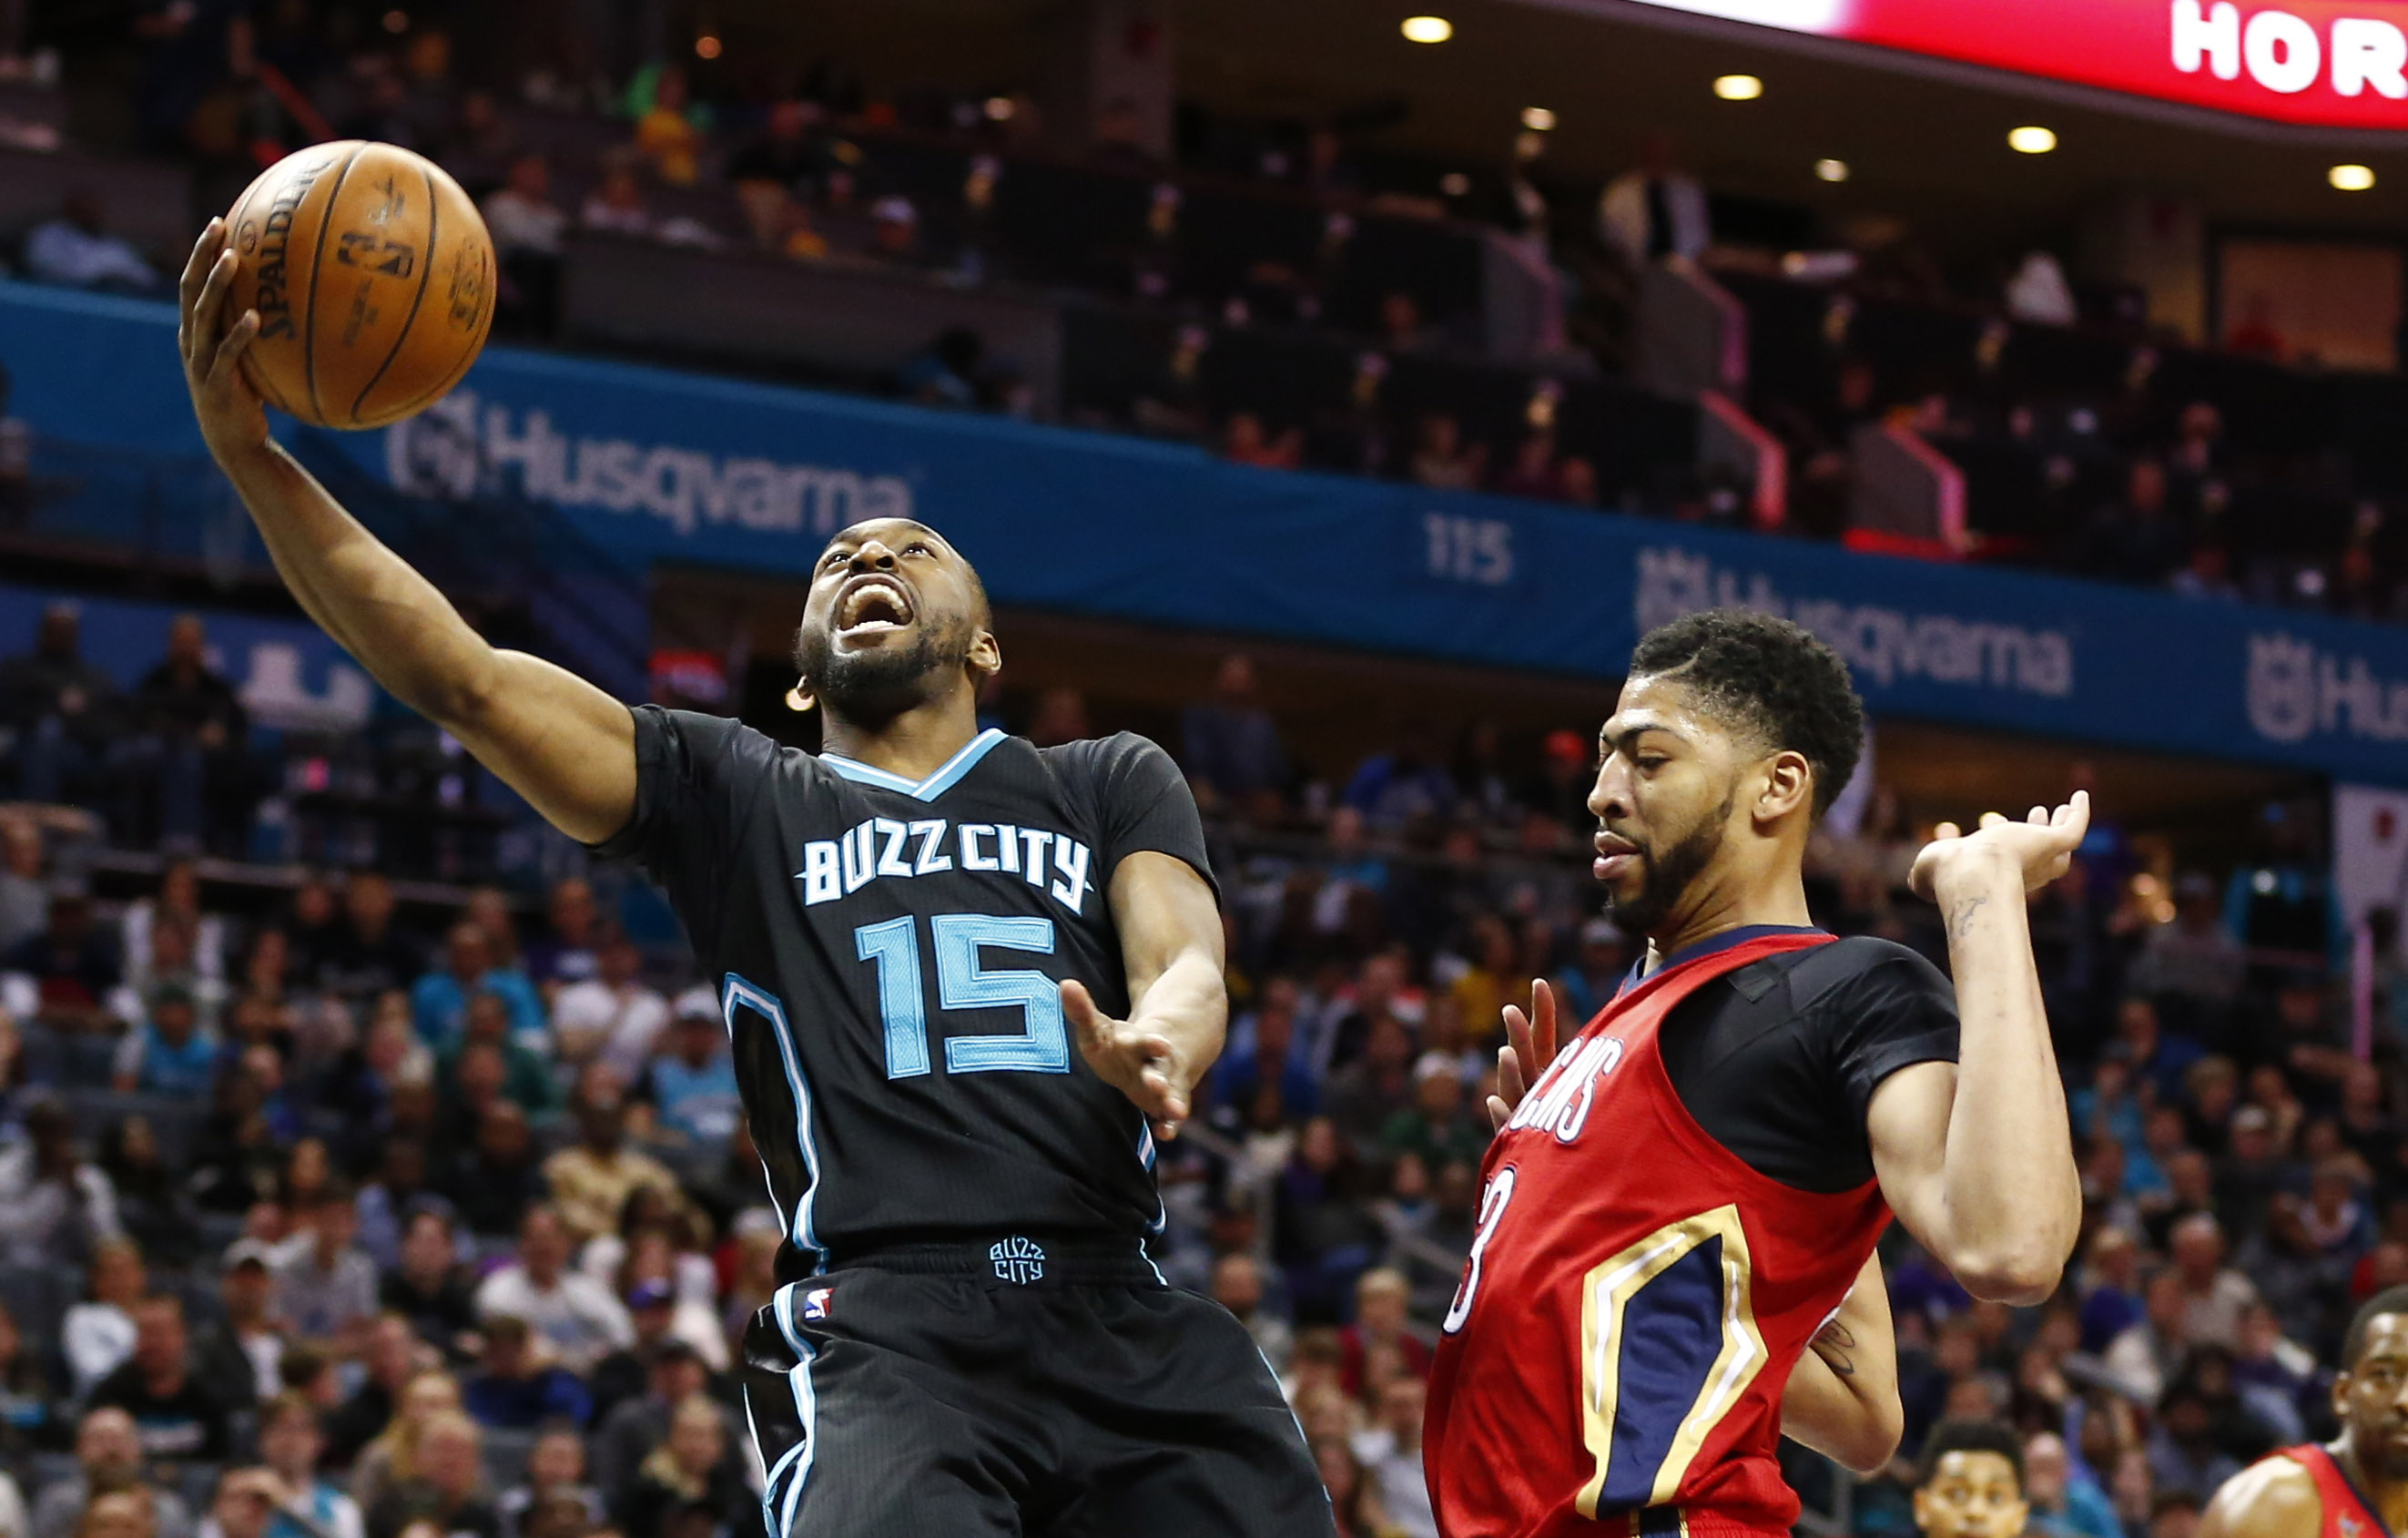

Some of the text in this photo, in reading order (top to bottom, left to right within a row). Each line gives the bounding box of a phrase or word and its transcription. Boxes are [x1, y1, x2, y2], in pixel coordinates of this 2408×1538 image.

[2173, 0, 2408, 98] HOR
[484, 402, 911, 535] Husqvarna
[1425, 514, 1512, 581] 115
[795, 818, 1094, 916] BUZZ CITY
[855, 915, 1070, 1080] 15
[990, 1237, 1045, 1260] BUZZ
[994, 1259, 1043, 1285] CITY
